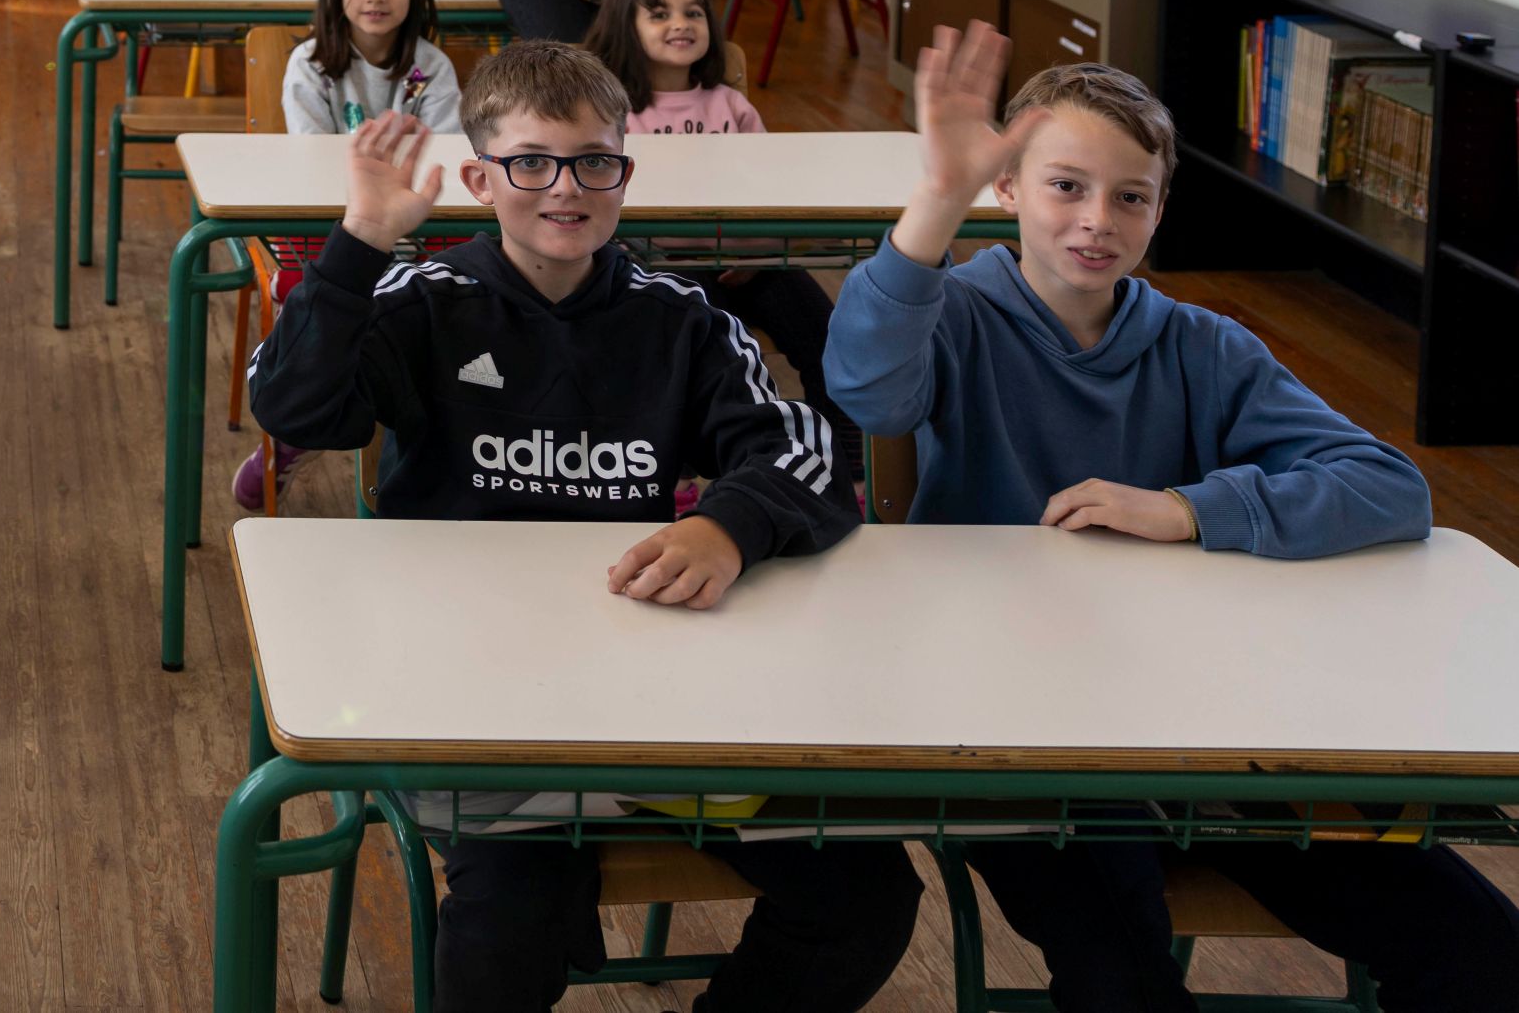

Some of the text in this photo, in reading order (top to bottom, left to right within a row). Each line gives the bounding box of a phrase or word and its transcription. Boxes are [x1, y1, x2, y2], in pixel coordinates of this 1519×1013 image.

[461, 369, 503, 388] adidas
[472, 429, 658, 480] adidas
[472, 473, 660, 500] SPORTSWEAR
